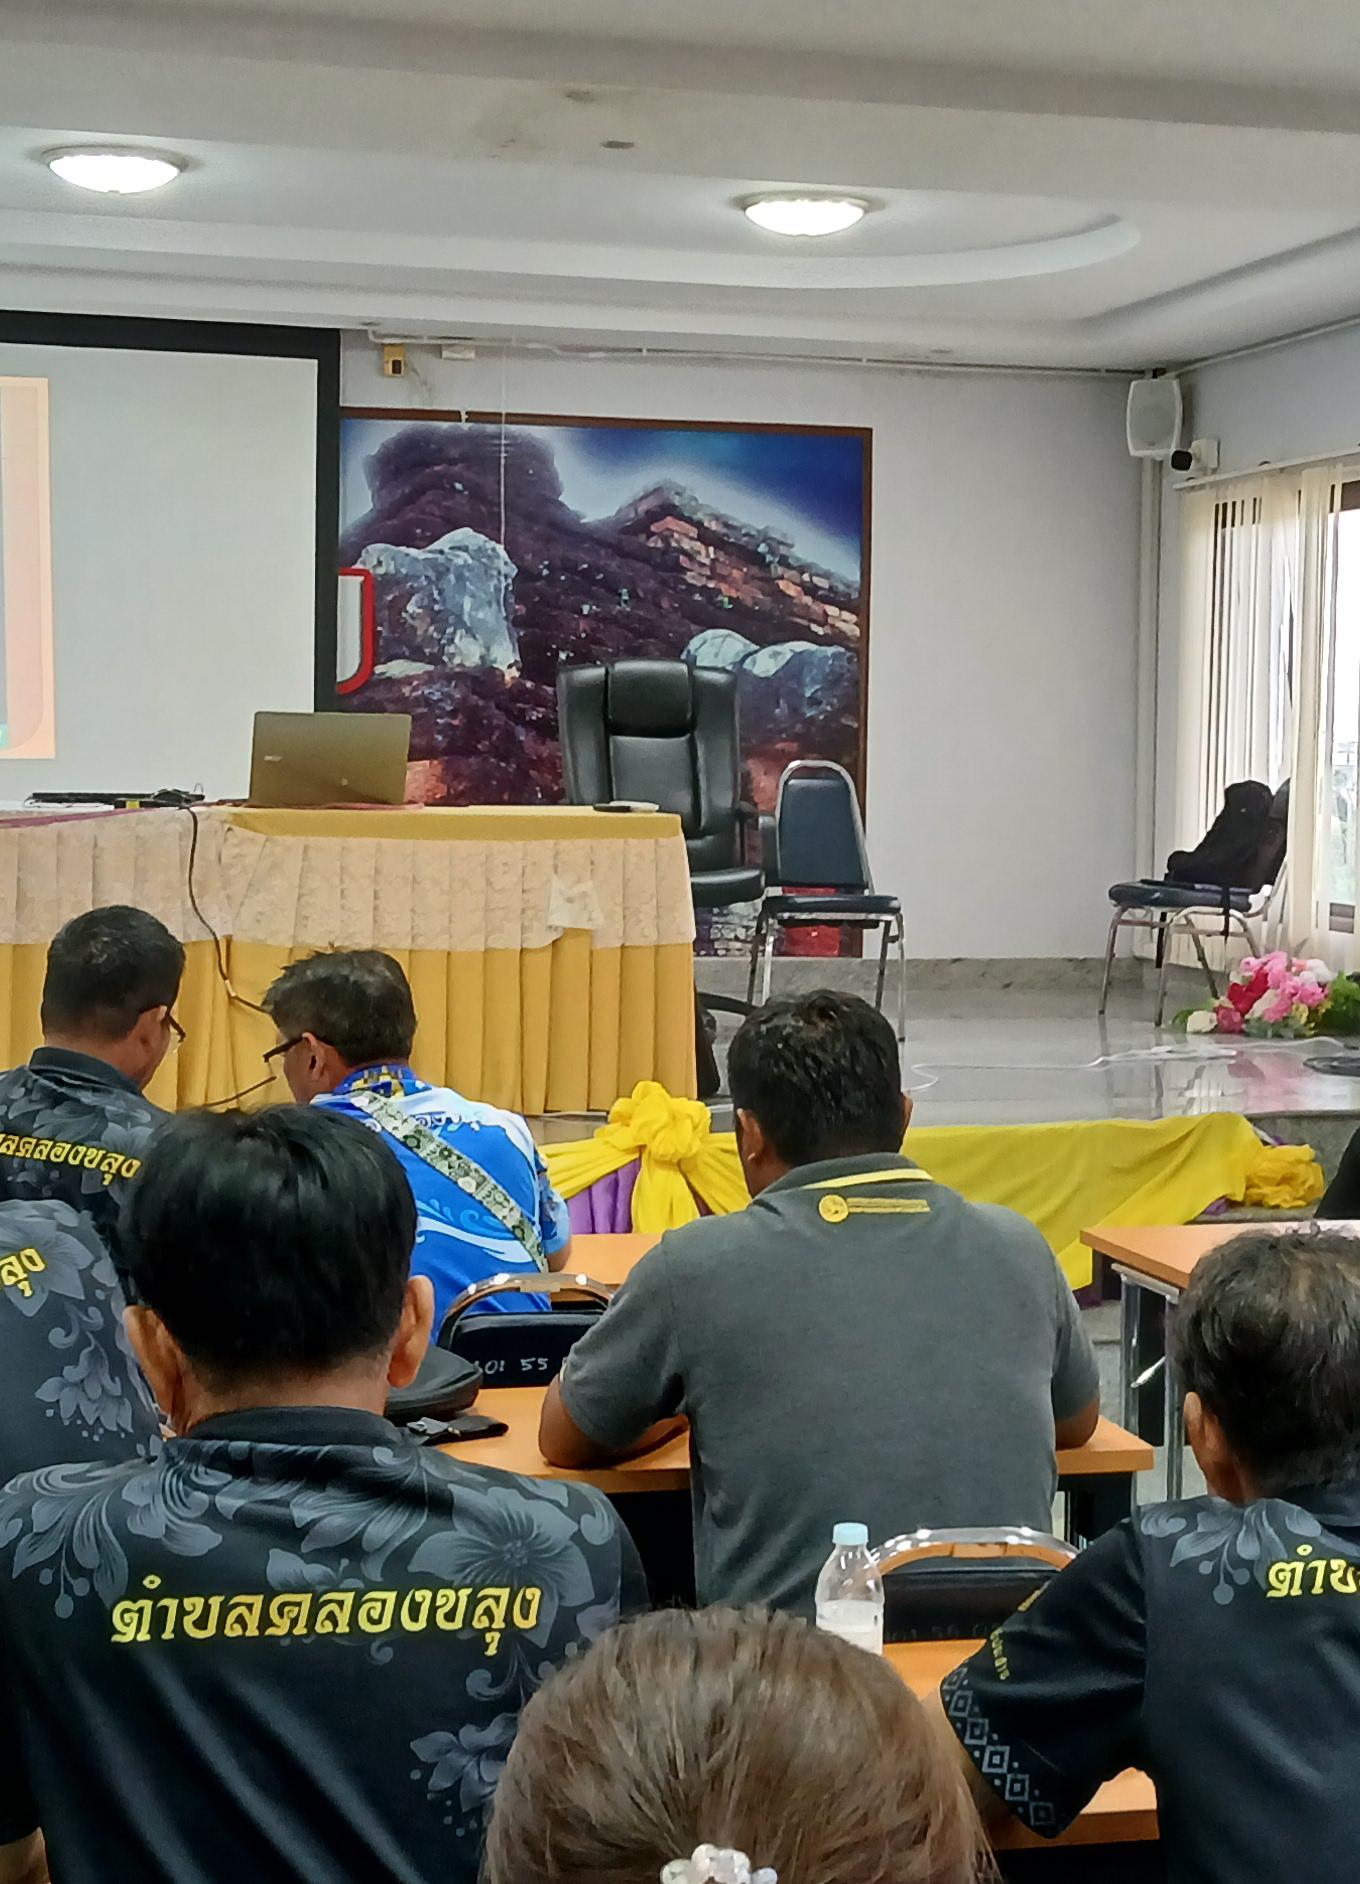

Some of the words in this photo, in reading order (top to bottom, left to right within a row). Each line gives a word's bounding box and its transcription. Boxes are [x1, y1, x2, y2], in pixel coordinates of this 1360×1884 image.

[520, 1357, 548, 1371] 55
[110, 1573, 542, 1656] ตำบลคลองขลุง
